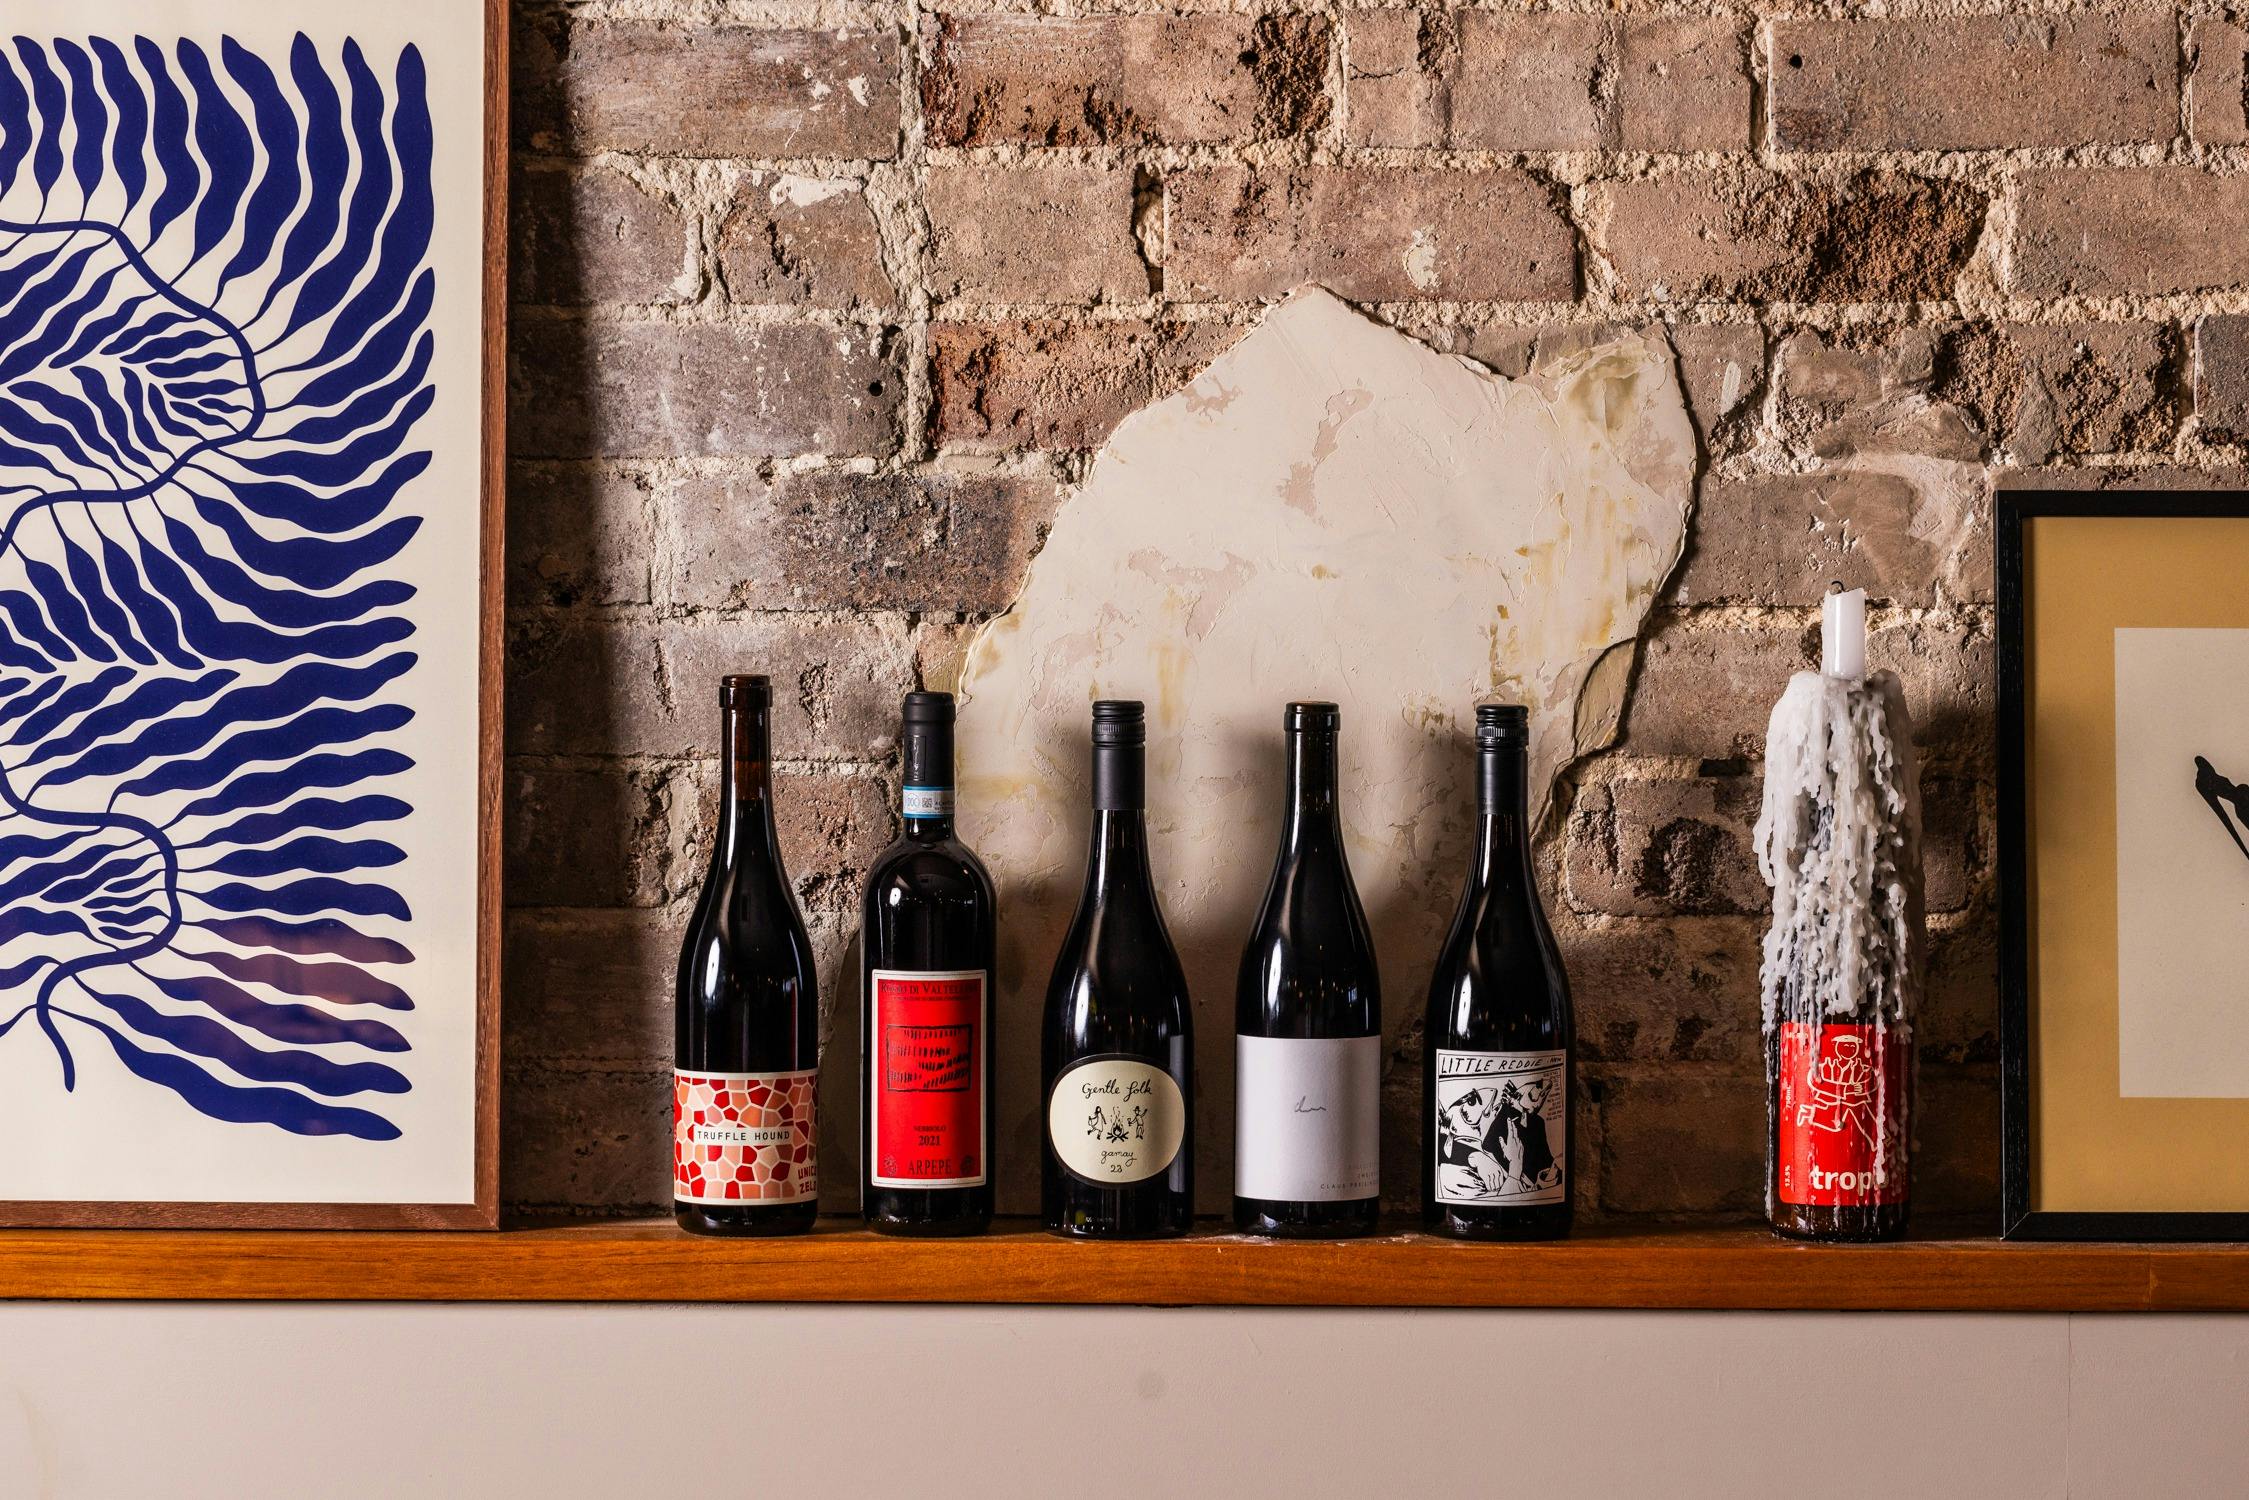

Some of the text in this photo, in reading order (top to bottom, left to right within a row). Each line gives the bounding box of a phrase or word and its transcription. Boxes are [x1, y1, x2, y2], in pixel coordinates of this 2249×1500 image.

[1441, 1057, 1494, 1074] LITTLE
[1498, 1059, 1543, 1071] REDDIE
[1081, 1079, 1152, 1102] Gentle folk
[697, 1130, 790, 1141] TRUFFLE HOUND
[918, 1135, 941, 1146] 2021
[1100, 1150, 1137, 1167] gamay
[1110, 1165, 1122, 1173] 23
